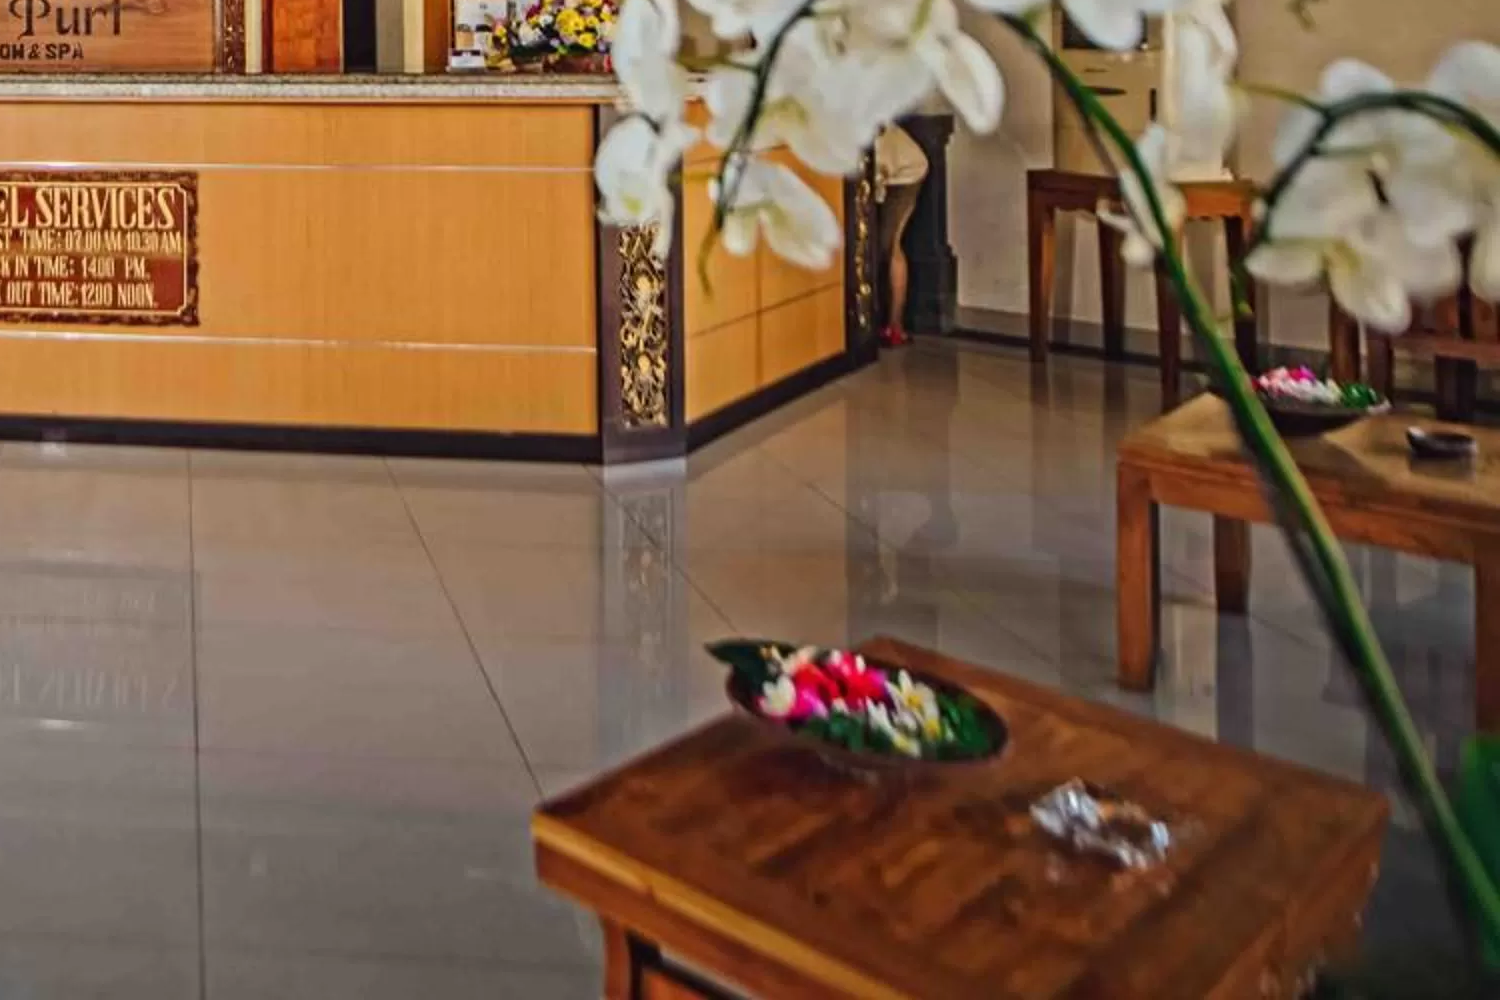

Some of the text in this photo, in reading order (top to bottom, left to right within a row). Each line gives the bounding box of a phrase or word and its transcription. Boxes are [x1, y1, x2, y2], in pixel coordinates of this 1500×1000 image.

[27, 43, 42, 60] &
[45, 43, 85, 60] SPA
[35, 187, 176, 229] SERVICES
[14, 256, 30, 278] IN
[6, 281, 34, 305] OUT
